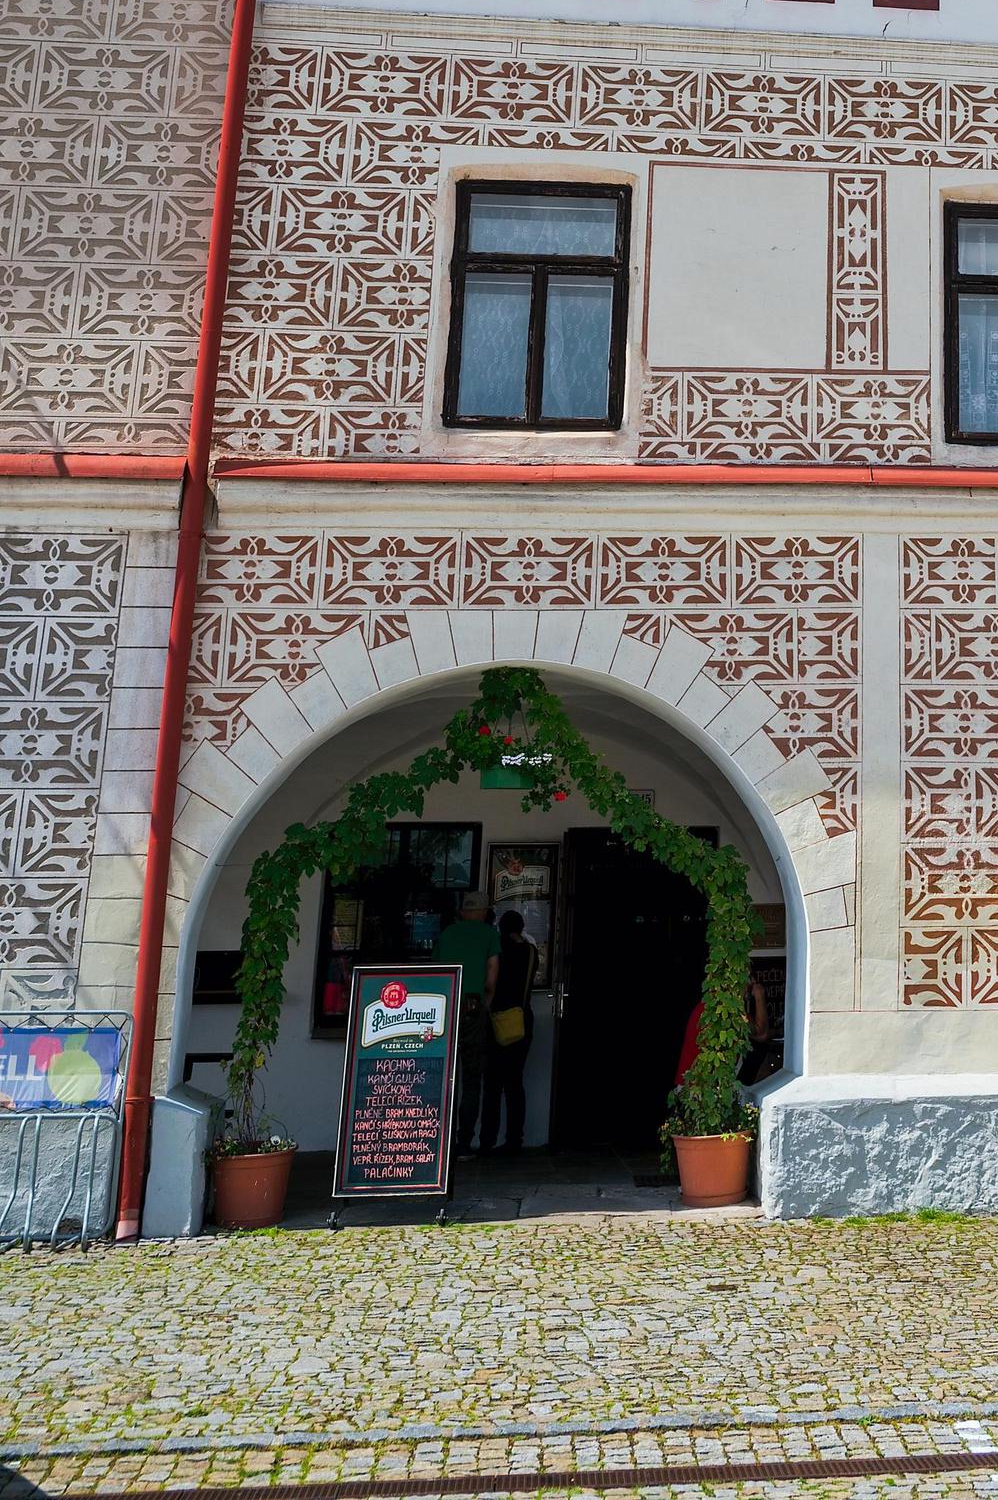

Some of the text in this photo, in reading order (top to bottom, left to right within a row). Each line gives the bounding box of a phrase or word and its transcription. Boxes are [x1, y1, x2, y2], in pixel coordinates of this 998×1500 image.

[372, 1007, 436, 1033] Pilsner Urquell
[376, 1059, 416, 1072] KACHNA
[367, 1072, 394, 1084] KANČÍ
[366, 1095, 396, 1107] TELECÍ
[352, 1130, 380, 1141] TELECÍ
[352, 1141, 381, 1153] PLNĚNÝ
[364, 1164, 414, 1179] PALAČINKY
